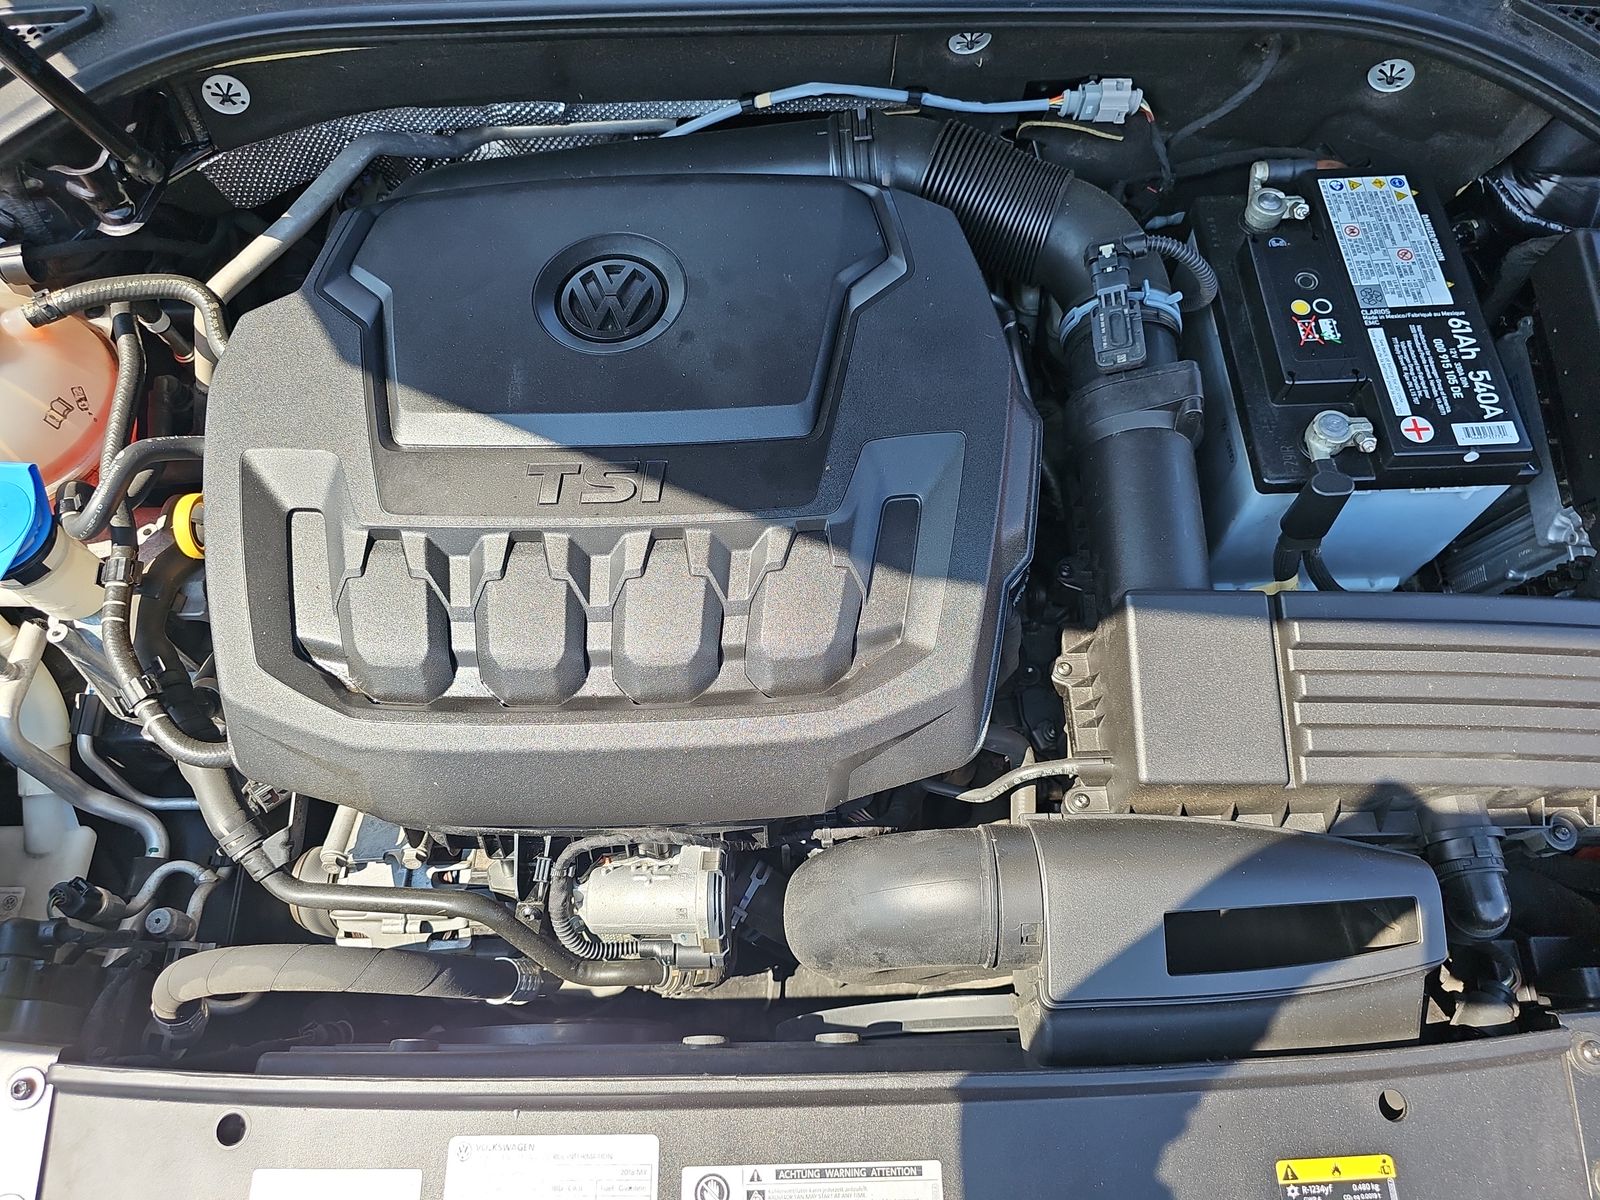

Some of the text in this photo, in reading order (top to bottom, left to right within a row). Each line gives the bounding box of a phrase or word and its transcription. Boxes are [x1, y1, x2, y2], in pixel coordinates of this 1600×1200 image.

[1421, 214, 1445, 261] DANGER/POISON
[1425, 356, 1440, 378] Volkswagen
[1432, 338, 1464, 398] 000 915 105 DE
[1448, 348, 1469, 388] 12V 330A DIN
[1448, 318, 1480, 360] 61Ah
[1468, 370, 1504, 419] 540A
[527, 460, 668, 505] TSI
[778, 1166, 917, 1179] ACHTUNG WARNING ATTENTION
[1302, 1184, 1333, 1195] R-1234yf
[1352, 1184, 1370, 1192] 0.480
[1372, 1183, 1380, 1192] kg
